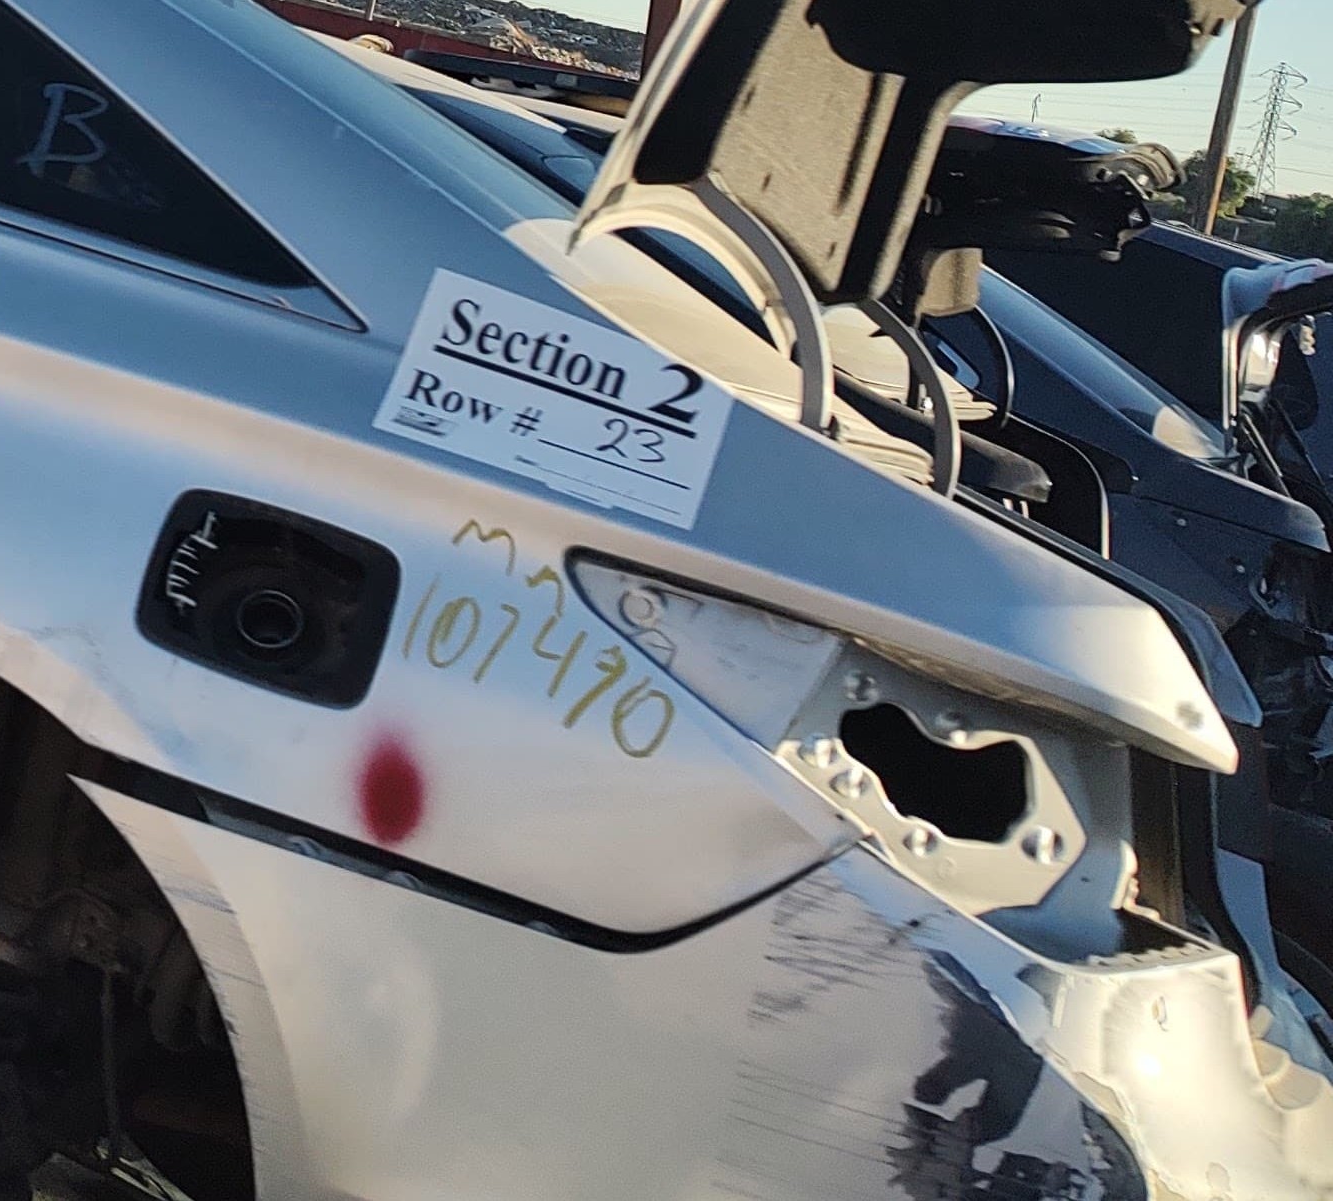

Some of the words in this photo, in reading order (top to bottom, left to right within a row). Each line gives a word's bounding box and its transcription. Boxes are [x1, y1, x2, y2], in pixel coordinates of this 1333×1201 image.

[17, 82, 109, 179] B
[440, 298, 628, 400] Section
[647, 363, 705, 424] 2
[405, 367, 504, 425] Row
[509, 405, 544, 438] #
[595, 417, 666, 464] 23
